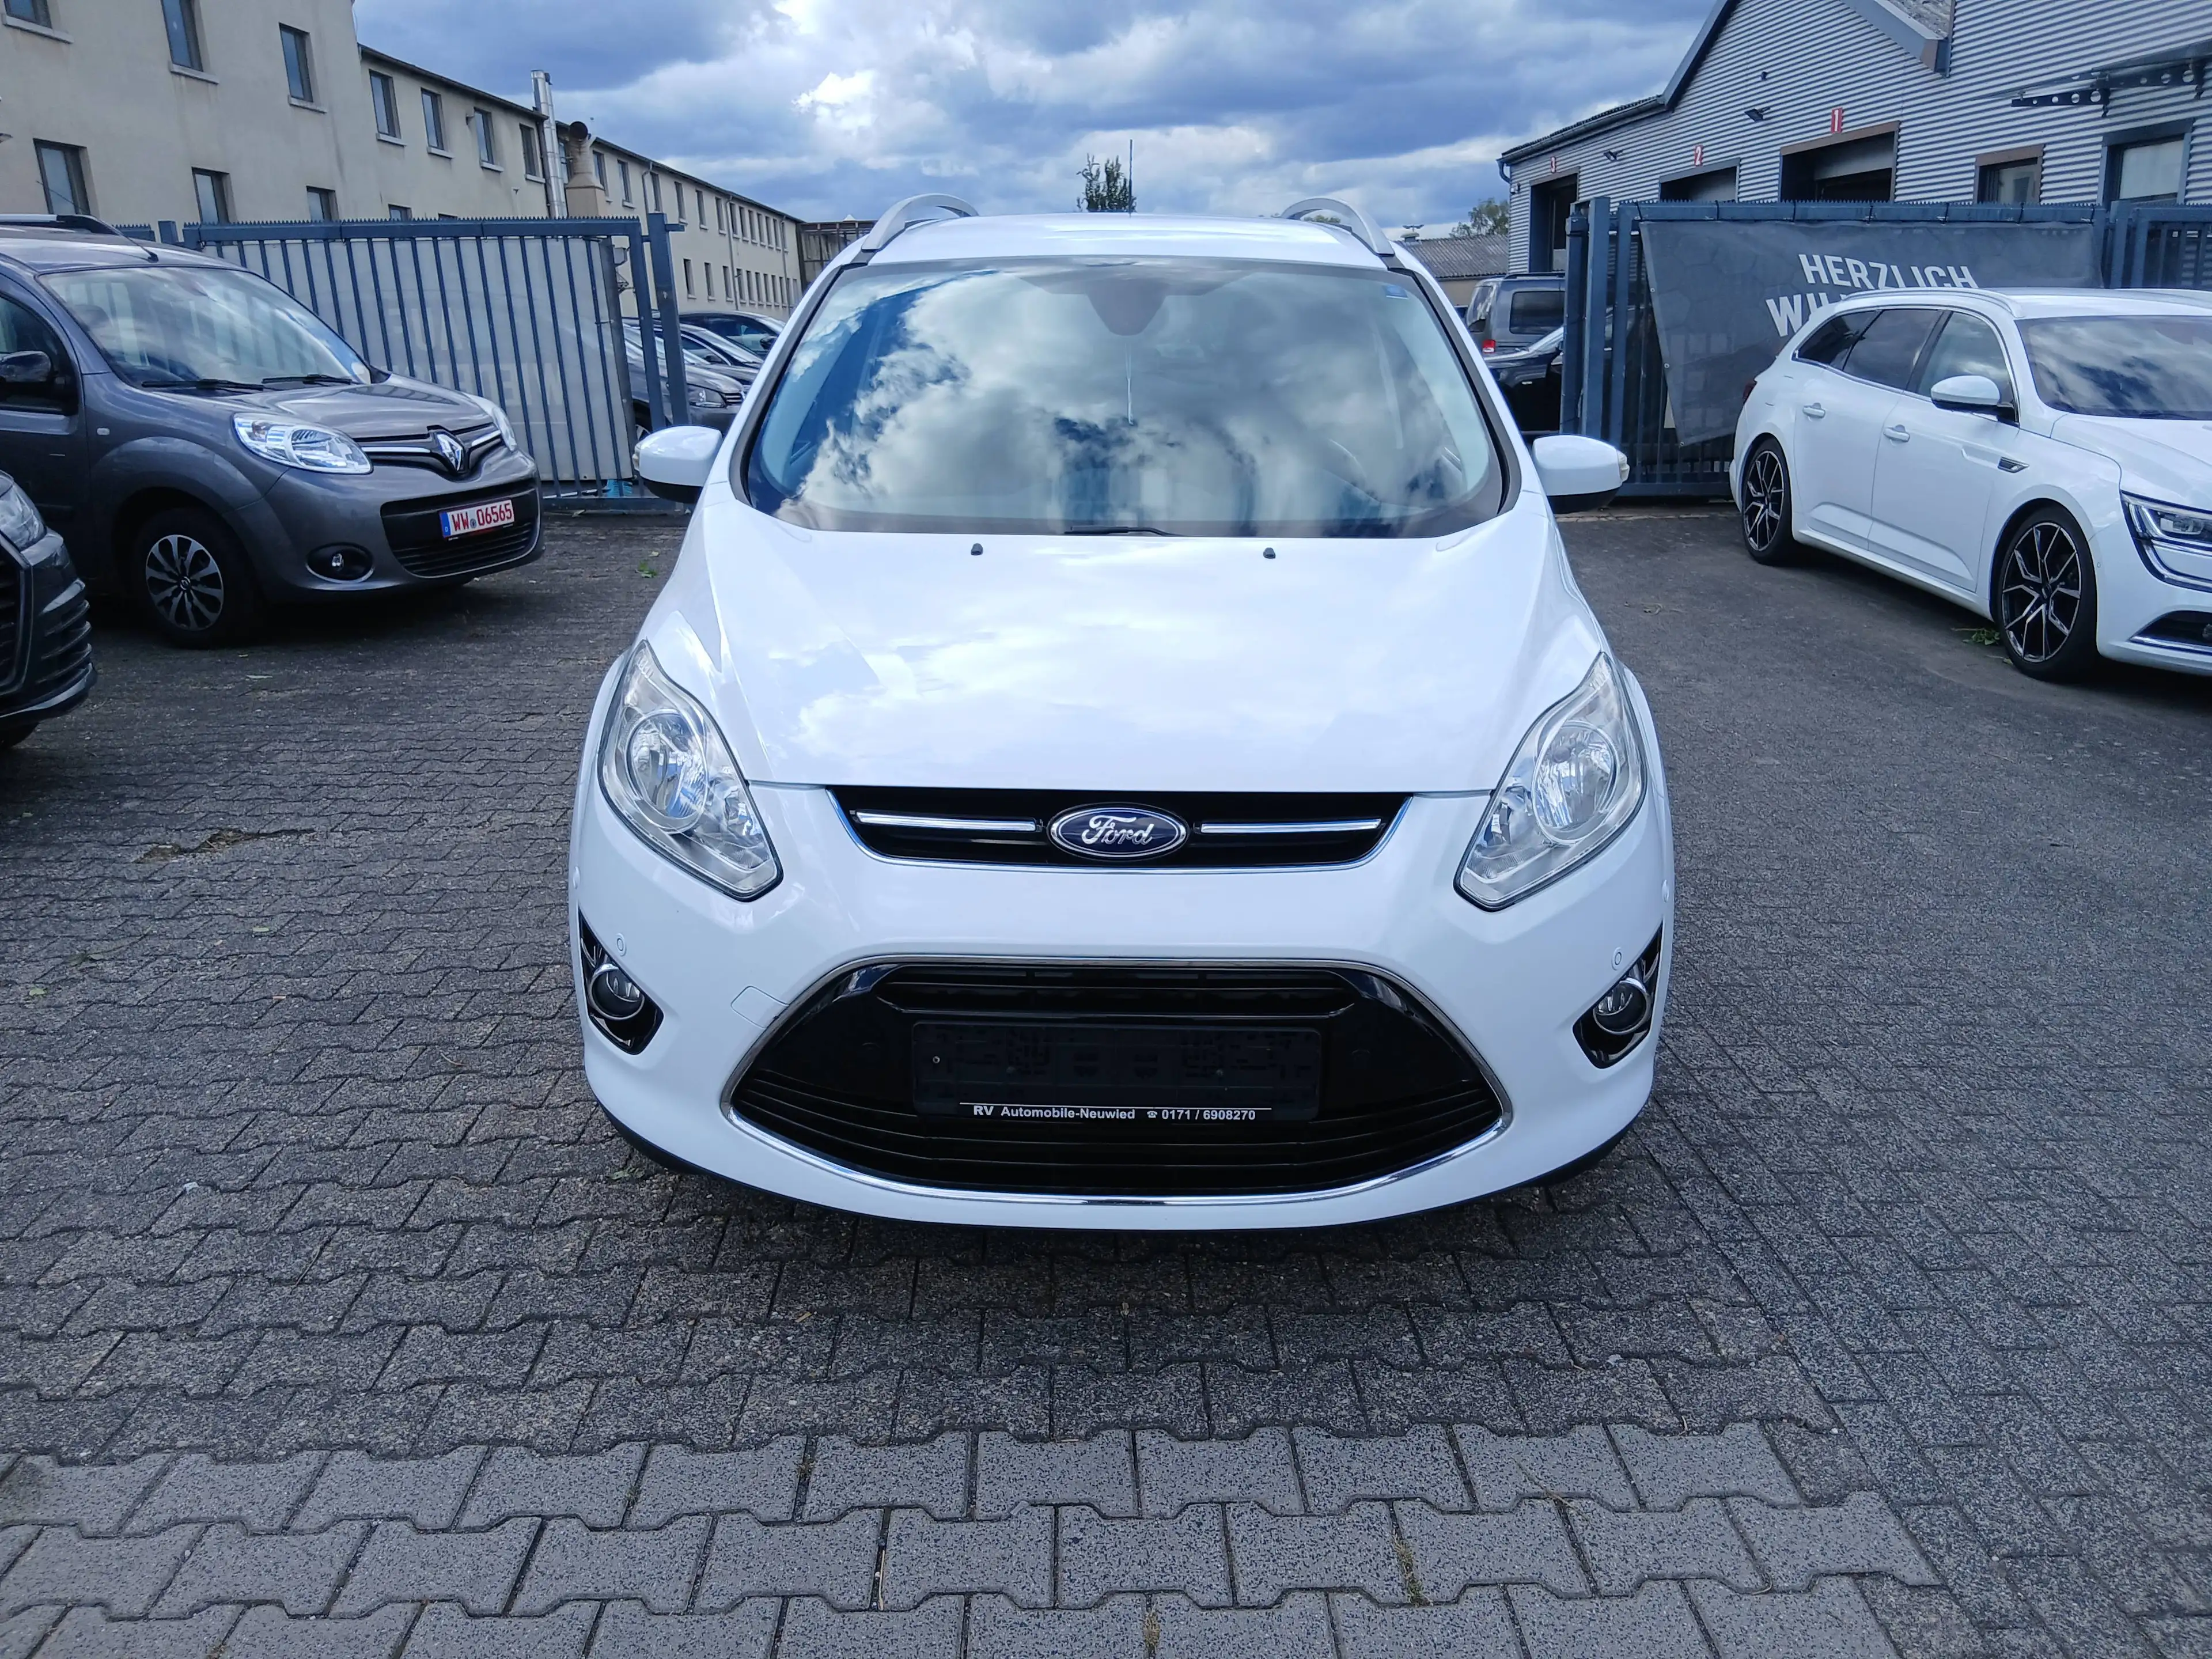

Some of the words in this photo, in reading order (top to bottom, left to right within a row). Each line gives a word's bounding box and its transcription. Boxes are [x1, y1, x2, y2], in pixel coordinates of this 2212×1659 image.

[1834, 109, 1839, 132] 1
[1551, 156, 1556, 173] 3
[1695, 146, 1702, 166] 2
[1798, 253, 1979, 289] HERZLICH
[452, 512, 469, 531] WW
[476, 503, 512, 526] 06565
[1081, 815, 1154, 845] Ford
[974, 1105, 994, 1116] RV
[1001, 1106, 1135, 1119] Automobile-Neuwied
[1161, 1109, 1191, 1120] 0171
[1203, 1110, 1256, 1120] 6908270
